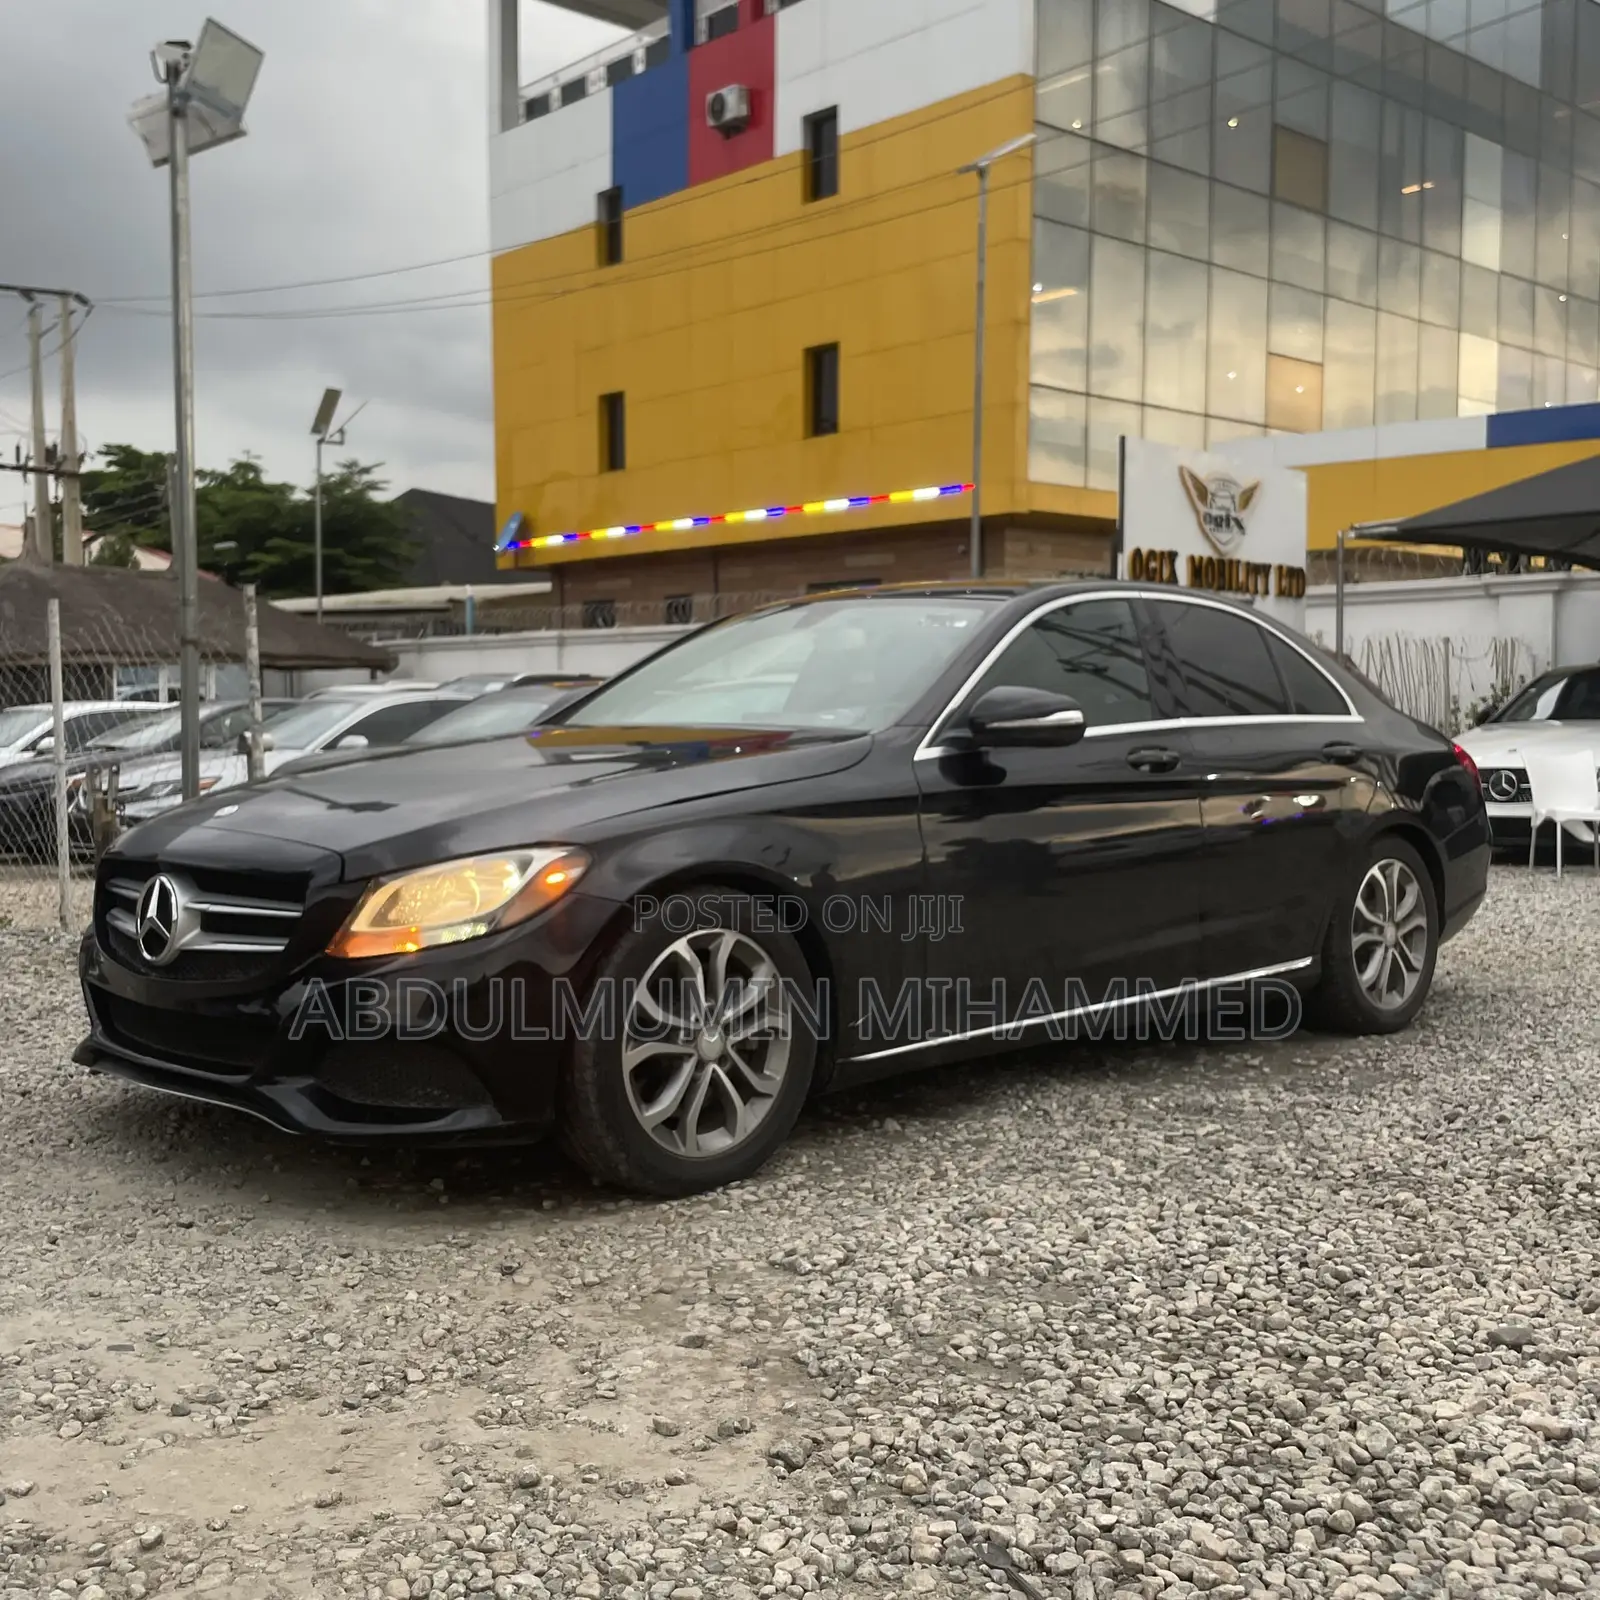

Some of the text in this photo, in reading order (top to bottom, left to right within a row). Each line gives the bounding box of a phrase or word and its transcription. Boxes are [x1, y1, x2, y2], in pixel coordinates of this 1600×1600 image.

[1129, 547, 1306, 599] OGIX MOBILITY LTD
